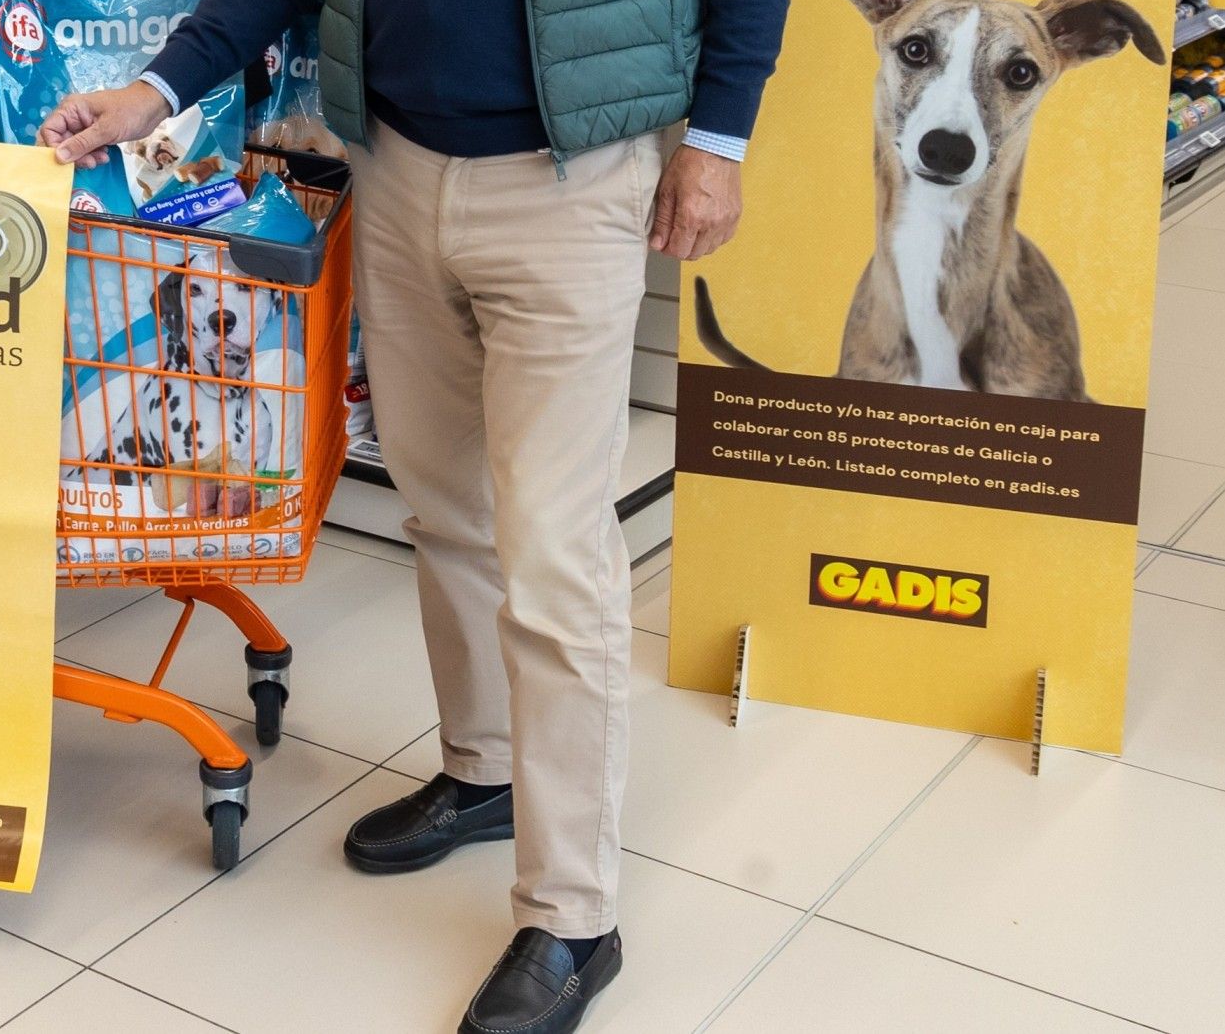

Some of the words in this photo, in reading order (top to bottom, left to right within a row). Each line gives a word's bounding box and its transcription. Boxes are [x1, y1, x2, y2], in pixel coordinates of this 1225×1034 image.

[10, 15, 40, 41] ifa
[174, 196, 185, 204] con
[186, 192, 199, 201] Aves
[205, 187, 215, 195] con
[215, 181, 235, 191] Conejo
[713, 418, 789, 438] colaborar
[793, 427, 823, 441] con
[827, 430, 847, 444] 85
[852, 433, 949, 457] protectoras
[954, 444, 975, 458] de
[979, 446, 1038, 466] Galicia
[1042, 456, 1053, 466] o
[714, 391, 754, 406] Dona
[758, 395, 833, 416] producto
[836, 403, 862, 418] y/o
[866, 405, 895, 422] haz
[899, 410, 991, 432] aportación
[995, 422, 1016, 434] en
[1020, 422, 1056, 440] caja
[1060, 427, 1100, 444] para
[712, 445, 771, 462] Castilla
[775, 455, 785, 466] y
[788, 453, 831, 470] León.
[836, 459, 896, 478] Listado
[900, 466, 980, 488] completo
[984, 476, 1005, 489] en
[1009, 479, 1080, 499] gadis.es
[819, 562, 982, 617] GADIS
